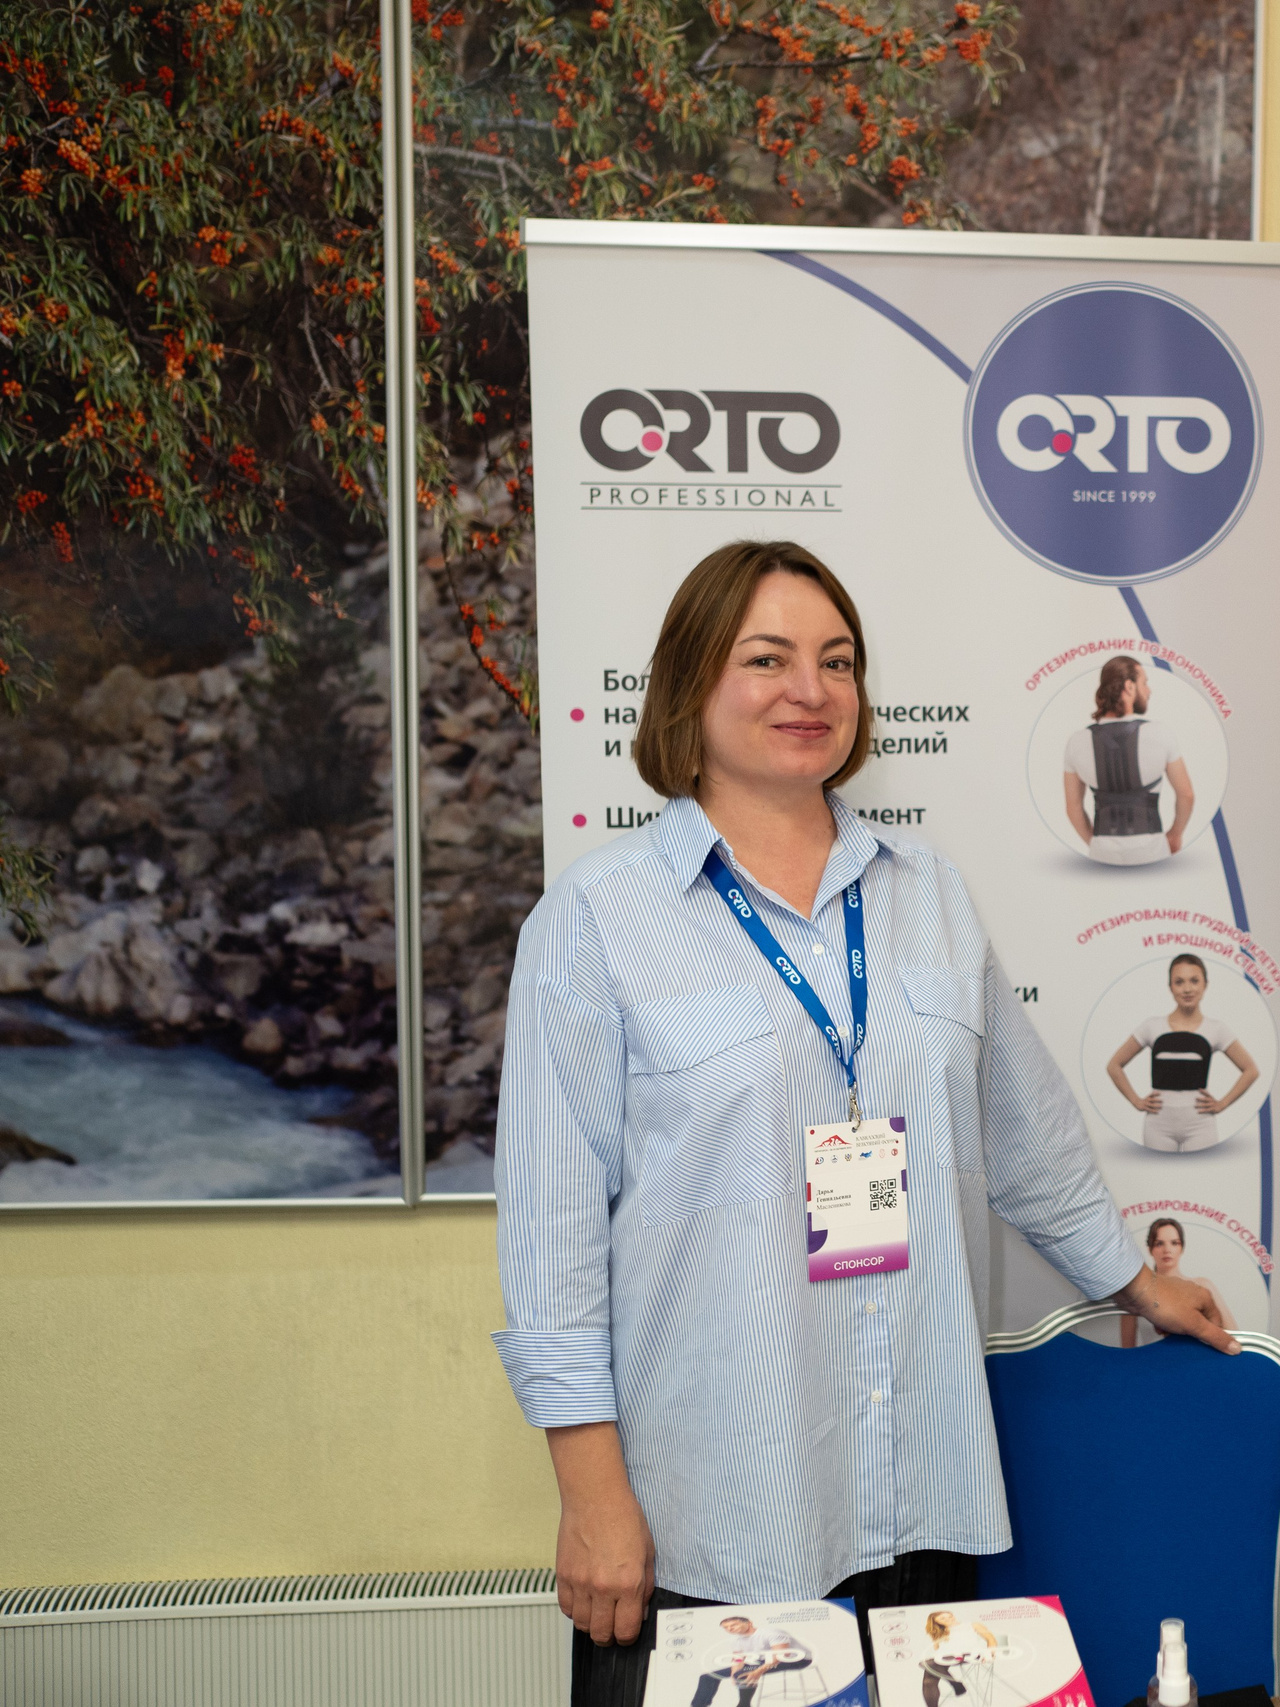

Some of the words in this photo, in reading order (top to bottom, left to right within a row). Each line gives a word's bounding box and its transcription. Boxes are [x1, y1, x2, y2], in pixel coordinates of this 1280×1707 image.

[580, 389, 841, 474] ORTO
[997, 394, 1232, 474] ORTO
[589, 488, 835, 507] PROFESSIONAL
[1072, 490, 1116, 503] SINCE
[1121, 490, 1157, 503] 1999
[1025, 639, 1135, 692] ОРТЕЗИРОВАНИЕ
[1138, 640, 1232, 719] ПОЗВОНОЧНИКА
[604, 706, 637, 724] на
[605, 739, 621, 756] и
[728, 888, 752, 918] ORTO
[1076, 909, 1190, 945] ОРТЕЗИРОВАНИЕ
[1192, 912, 1251, 947] ГРУДНОЙ
[776, 956, 801, 985] ORTO
[852, 949, 863, 979] ORTO
[1142, 935, 1155, 948] И
[1157, 933, 1234, 958] БРЮШНОЙ
[1233, 953, 1275, 995] СТЕНКИ
[1121, 1200, 1228, 1224] РТЕЗИРОВАНИЕ
[1226, 1218, 1275, 1274] СУСТАВОВ
[834, 1256, 885, 1271] СПОНСОР
